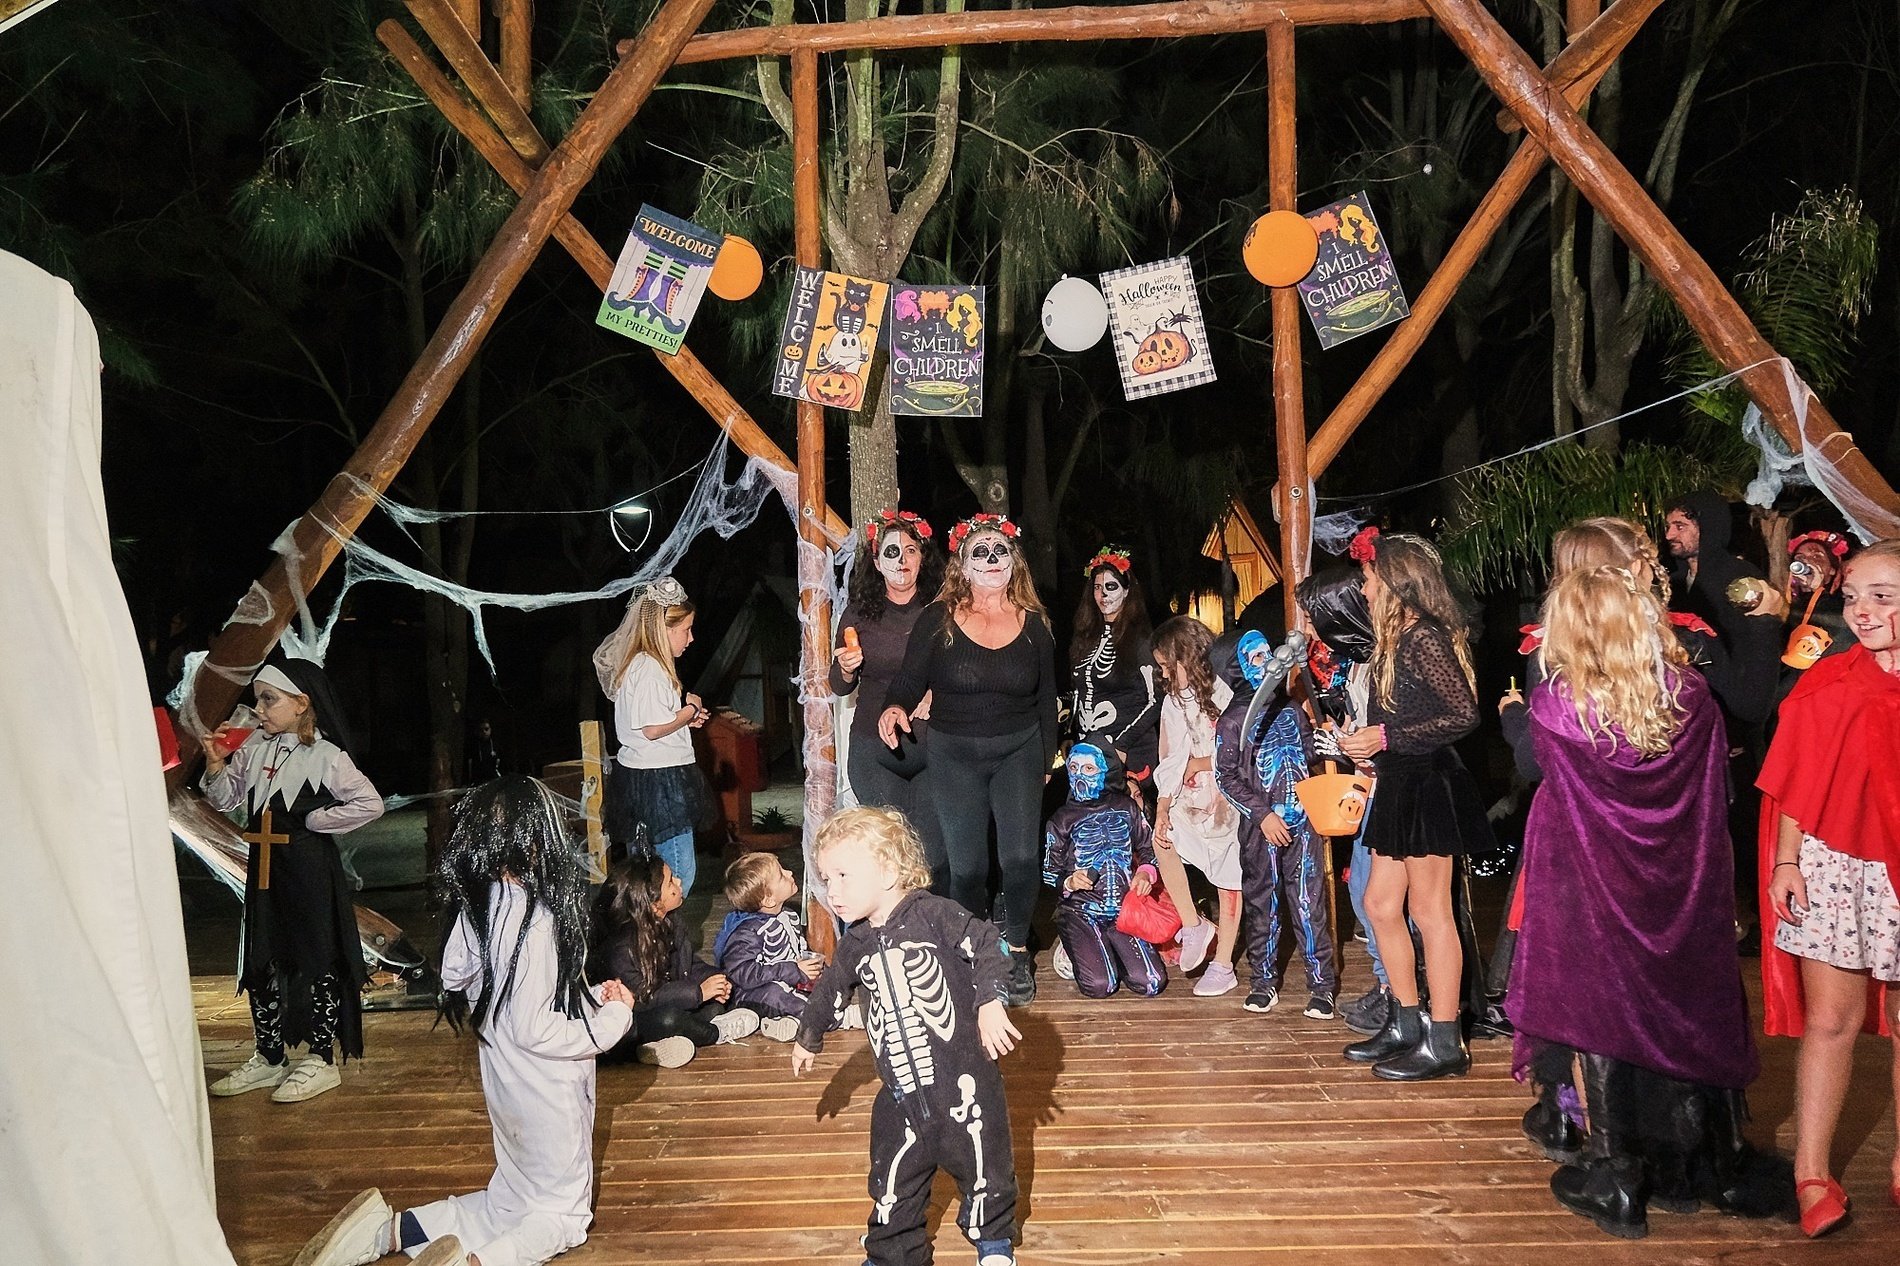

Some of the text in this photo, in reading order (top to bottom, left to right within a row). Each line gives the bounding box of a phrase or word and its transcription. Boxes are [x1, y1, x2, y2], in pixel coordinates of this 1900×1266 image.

[639, 217, 717, 259] WELCOME
[1331, 242, 1340, 254] I
[1318, 251, 1368, 282] SMELL
[1153, 274, 1178, 285] HAPPY
[1307, 260, 1392, 306] CHILDREN
[1119, 281, 1181, 305] Halloween
[605, 311, 679, 349] MY PRETTIES!
[935, 321, 943, 334] I
[911, 336, 963, 355] SMELL
[893, 356, 982, 380] CHILDREN
